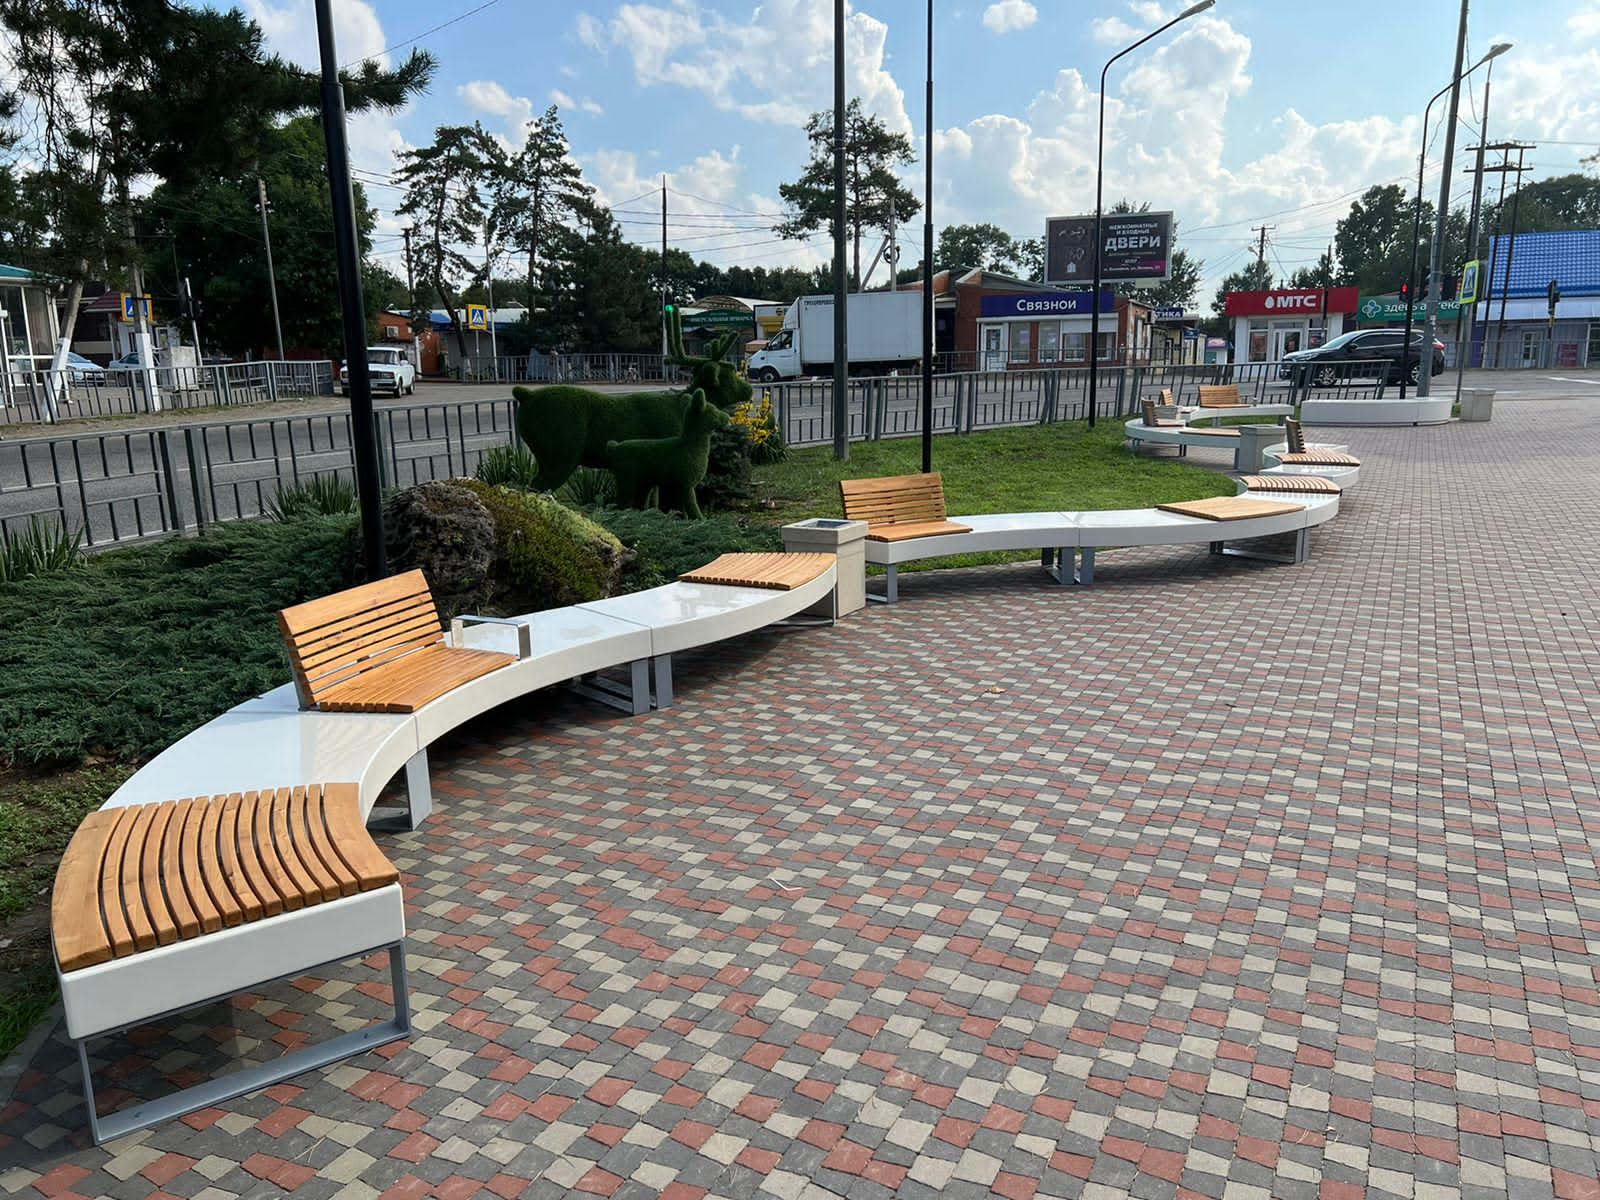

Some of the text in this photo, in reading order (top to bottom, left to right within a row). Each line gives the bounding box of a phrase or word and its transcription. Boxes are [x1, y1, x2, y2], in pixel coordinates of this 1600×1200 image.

[1104, 236, 1161, 252] ДВЕРИ
[1276, 295, 1317, 308] МТС
[1419, 302, 1461, 312] аека
[1155, 311, 1181, 319] ТИКА
